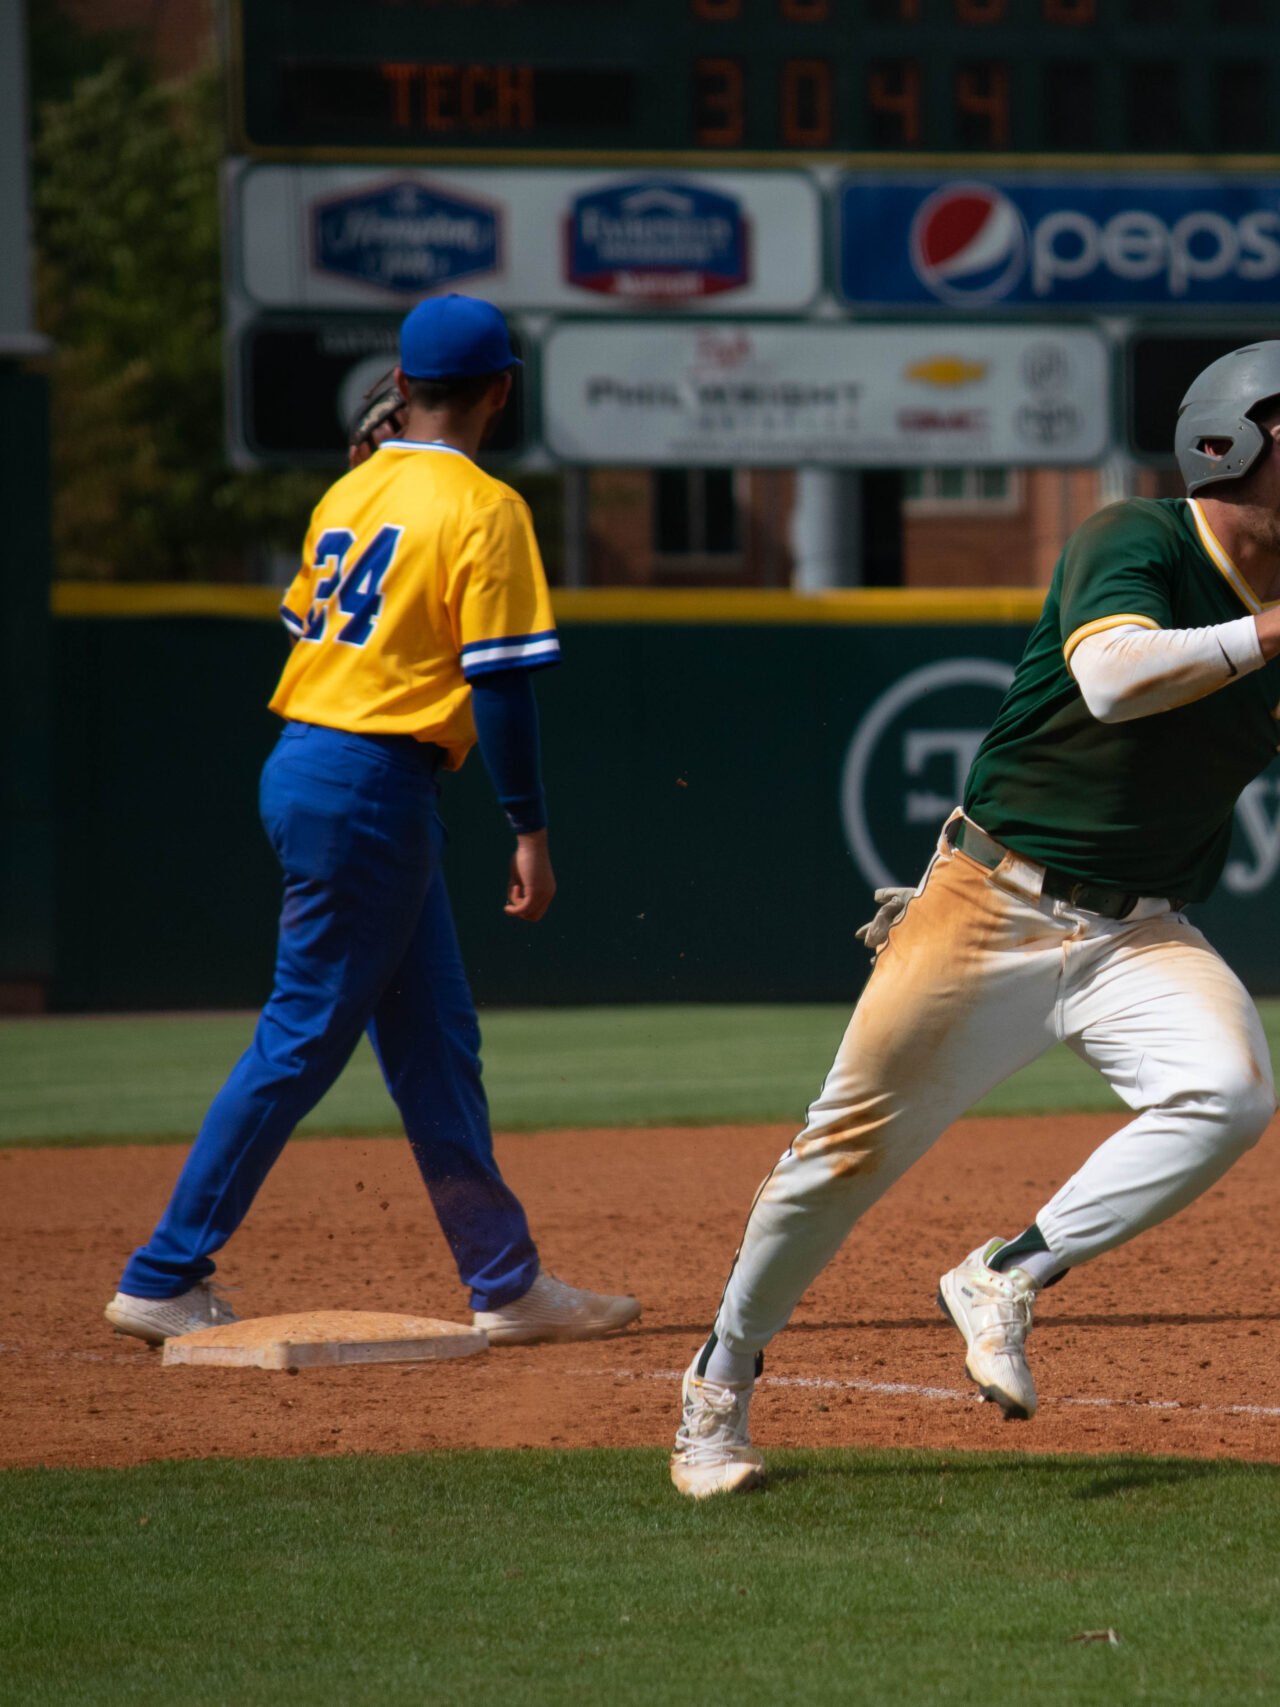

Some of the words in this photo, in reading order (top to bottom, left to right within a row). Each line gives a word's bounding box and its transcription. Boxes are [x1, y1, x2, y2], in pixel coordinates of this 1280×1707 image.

[381, 61, 536, 131] TECH
[692, 56, 746, 149] 3
[779, 57, 832, 149] 0
[867, 57, 921, 149] 4
[954, 57, 1011, 149] 4
[299, 522, 405, 649] 24
